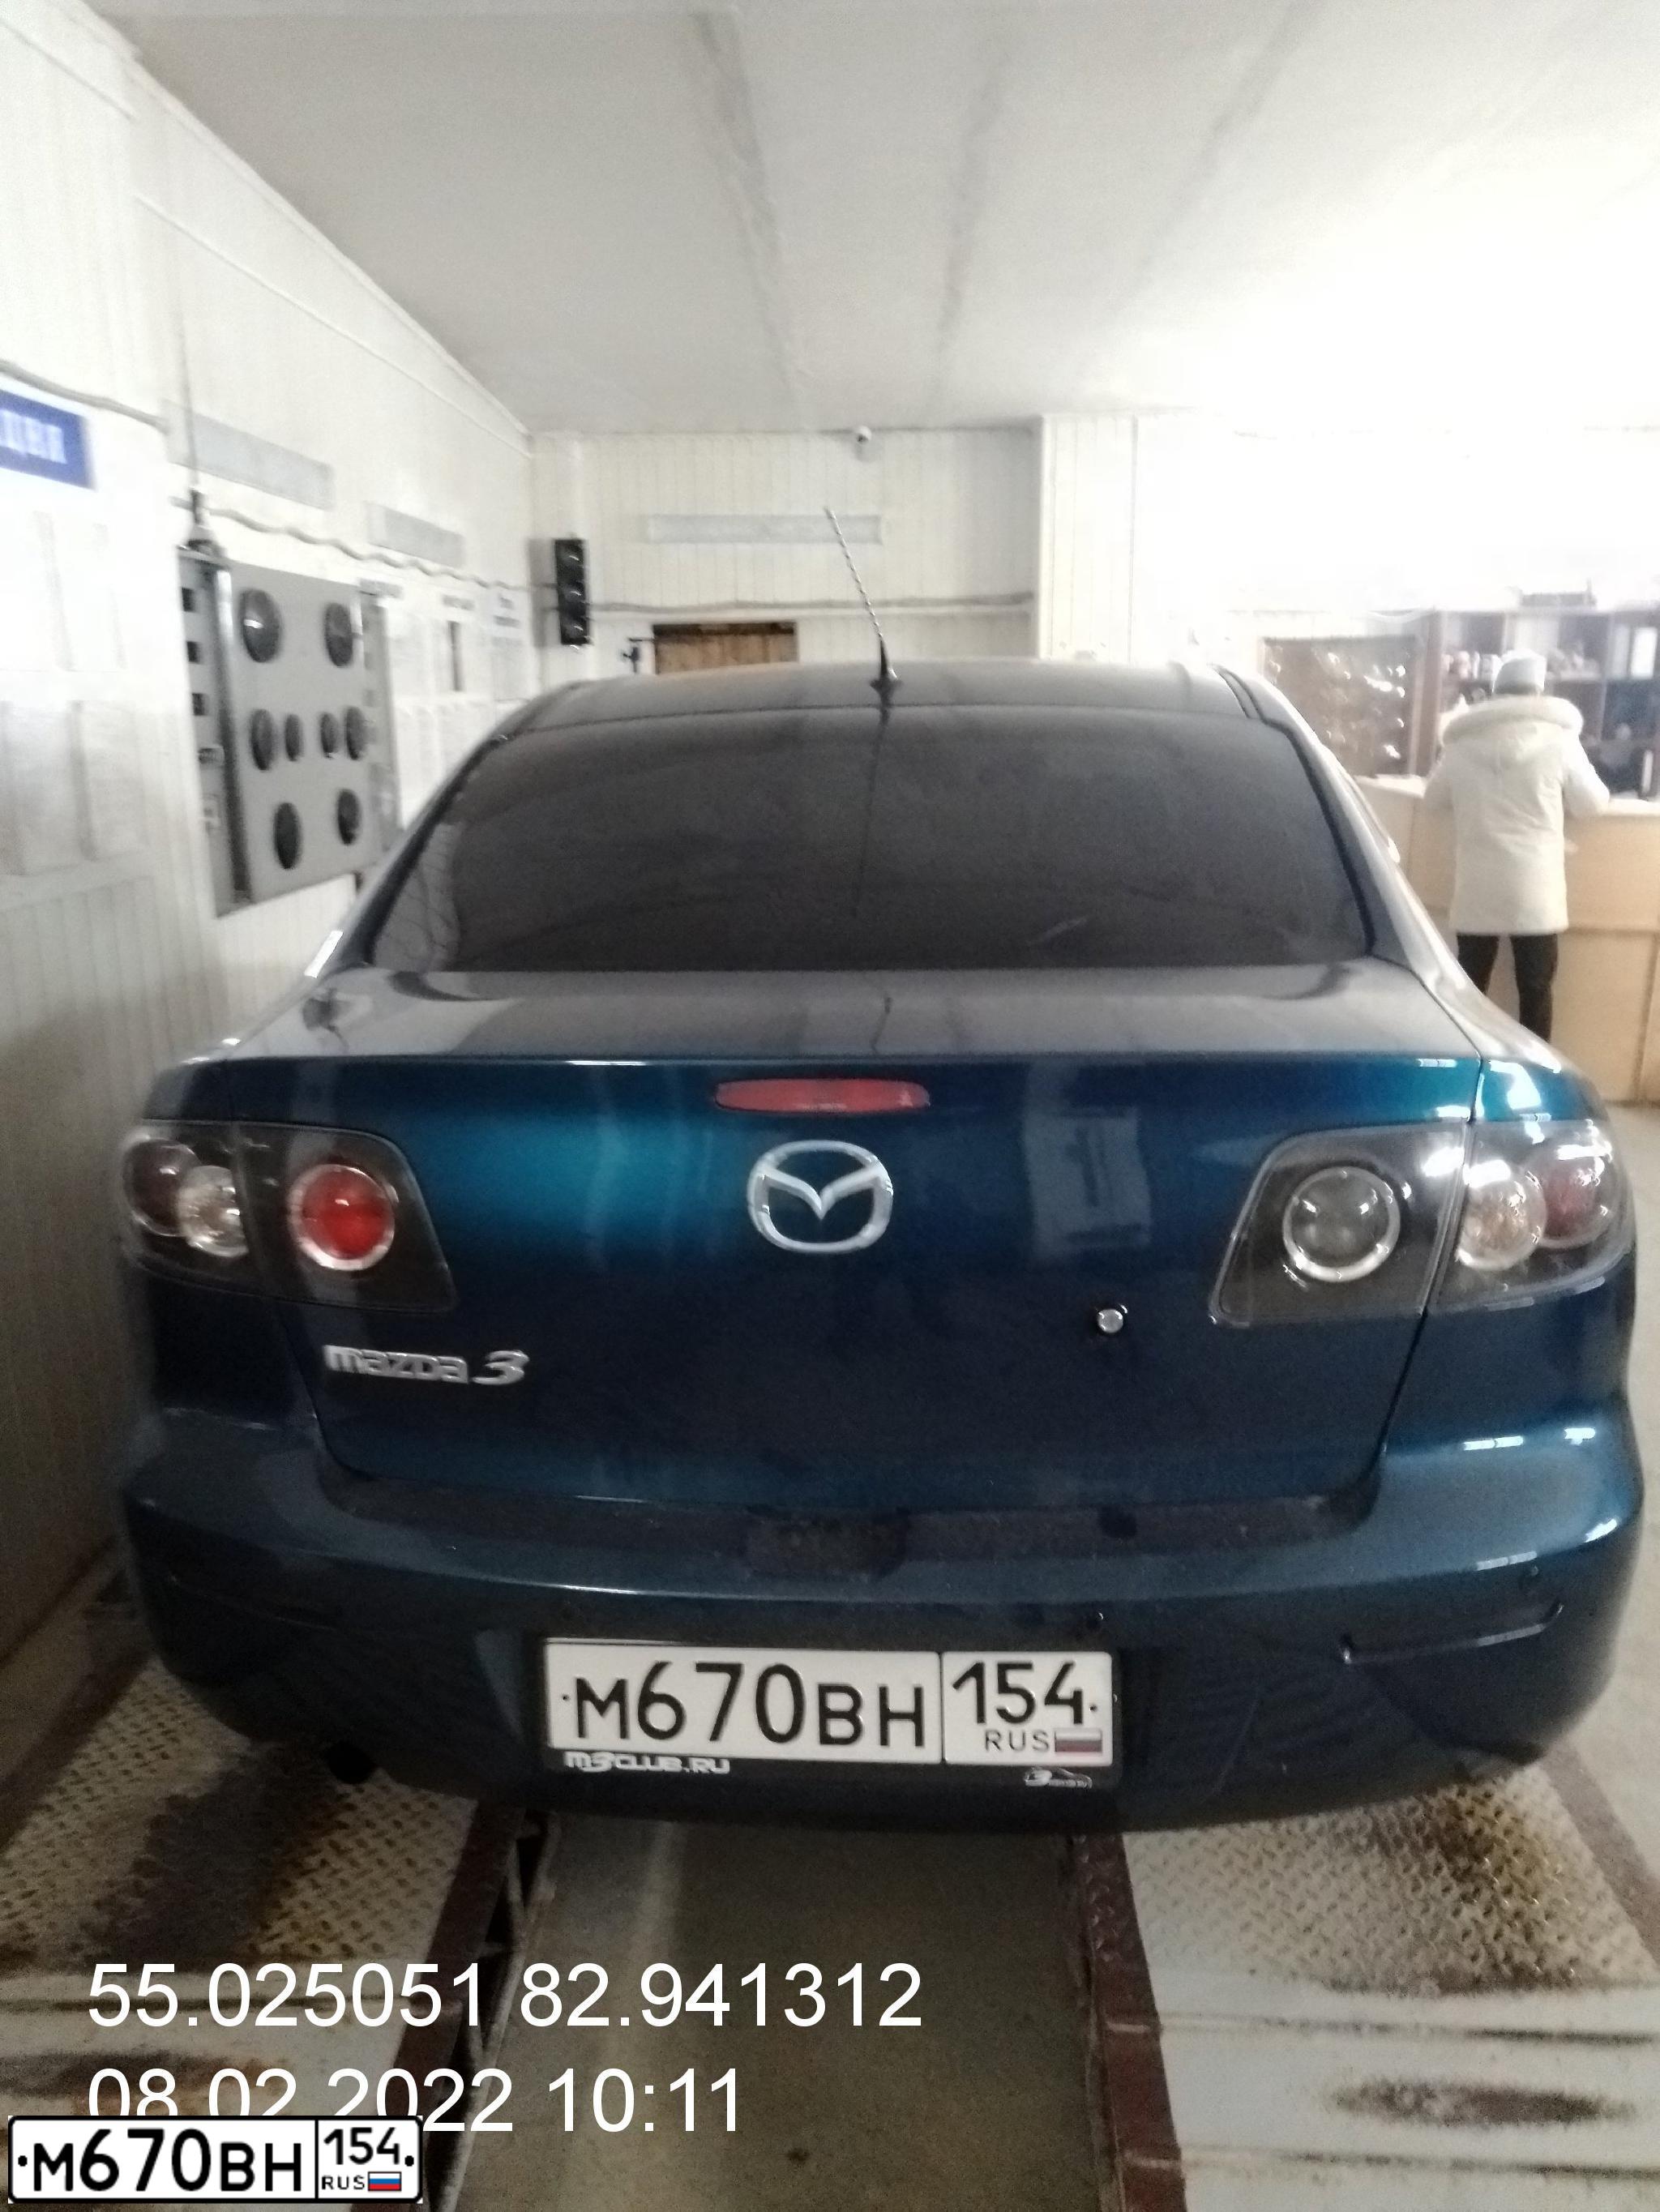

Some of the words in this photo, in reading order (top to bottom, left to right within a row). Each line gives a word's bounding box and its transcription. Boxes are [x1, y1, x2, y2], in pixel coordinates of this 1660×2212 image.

[472, 1350, 530, 1385] 3
[575, 1661, 924, 1748] М670ВН
[952, 1662, 1084, 1725] 154
[985, 1730, 1051, 1752] RUS
